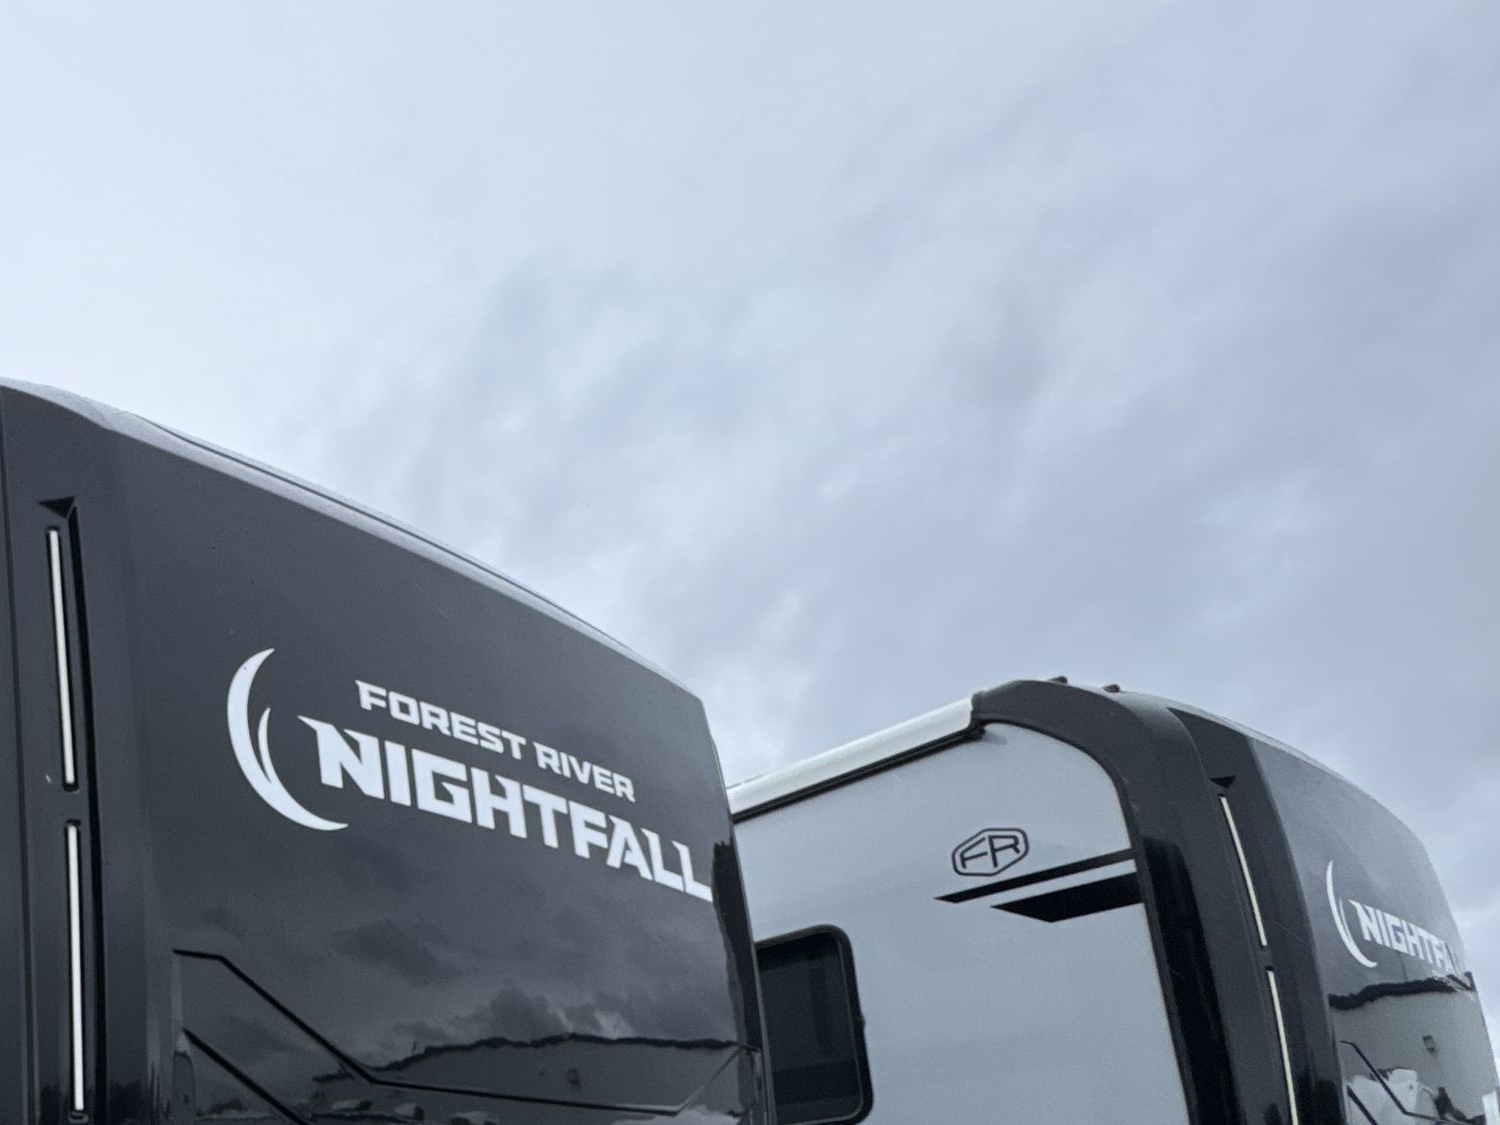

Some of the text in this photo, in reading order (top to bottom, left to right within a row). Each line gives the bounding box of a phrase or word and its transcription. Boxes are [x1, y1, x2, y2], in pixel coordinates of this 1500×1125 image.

[297, 715, 713, 904] NIGHTFALL
[355, 679, 637, 803] FOREST RIVER
